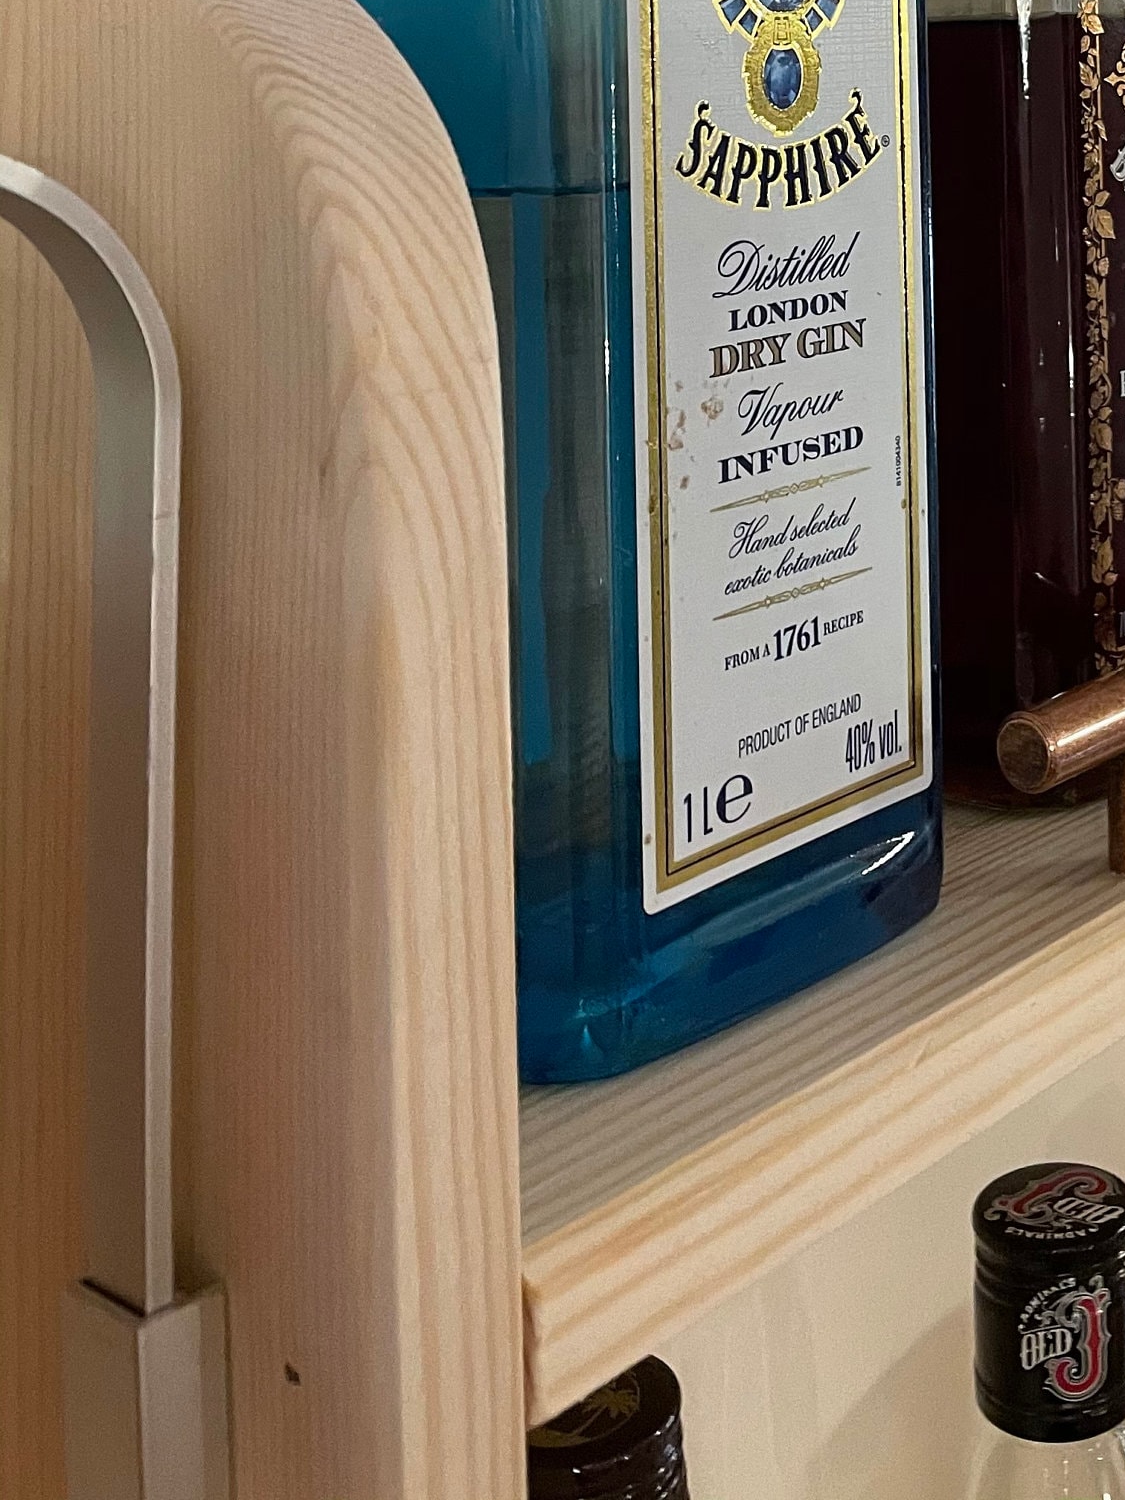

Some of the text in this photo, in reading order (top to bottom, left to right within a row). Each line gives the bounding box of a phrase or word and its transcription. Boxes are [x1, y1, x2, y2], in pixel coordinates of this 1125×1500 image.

[676, 88, 882, 210] SAPPHIRE
[713, 232, 859, 299] Distilled
[728, 290, 848, 333] LONDON
[709, 318, 867, 378] DRY GIN
[738, 383, 844, 441] Vapour
[717, 426, 864, 484] INFUSED
[728, 497, 857, 559] Hand selected
[724, 524, 861, 596] exotic botanicals
[724, 610, 864, 670] FROM A 1761 RECIPE
[738, 692, 862, 758] PRODUCT OF ENGLAND
[845, 718, 876, 774] 40%
